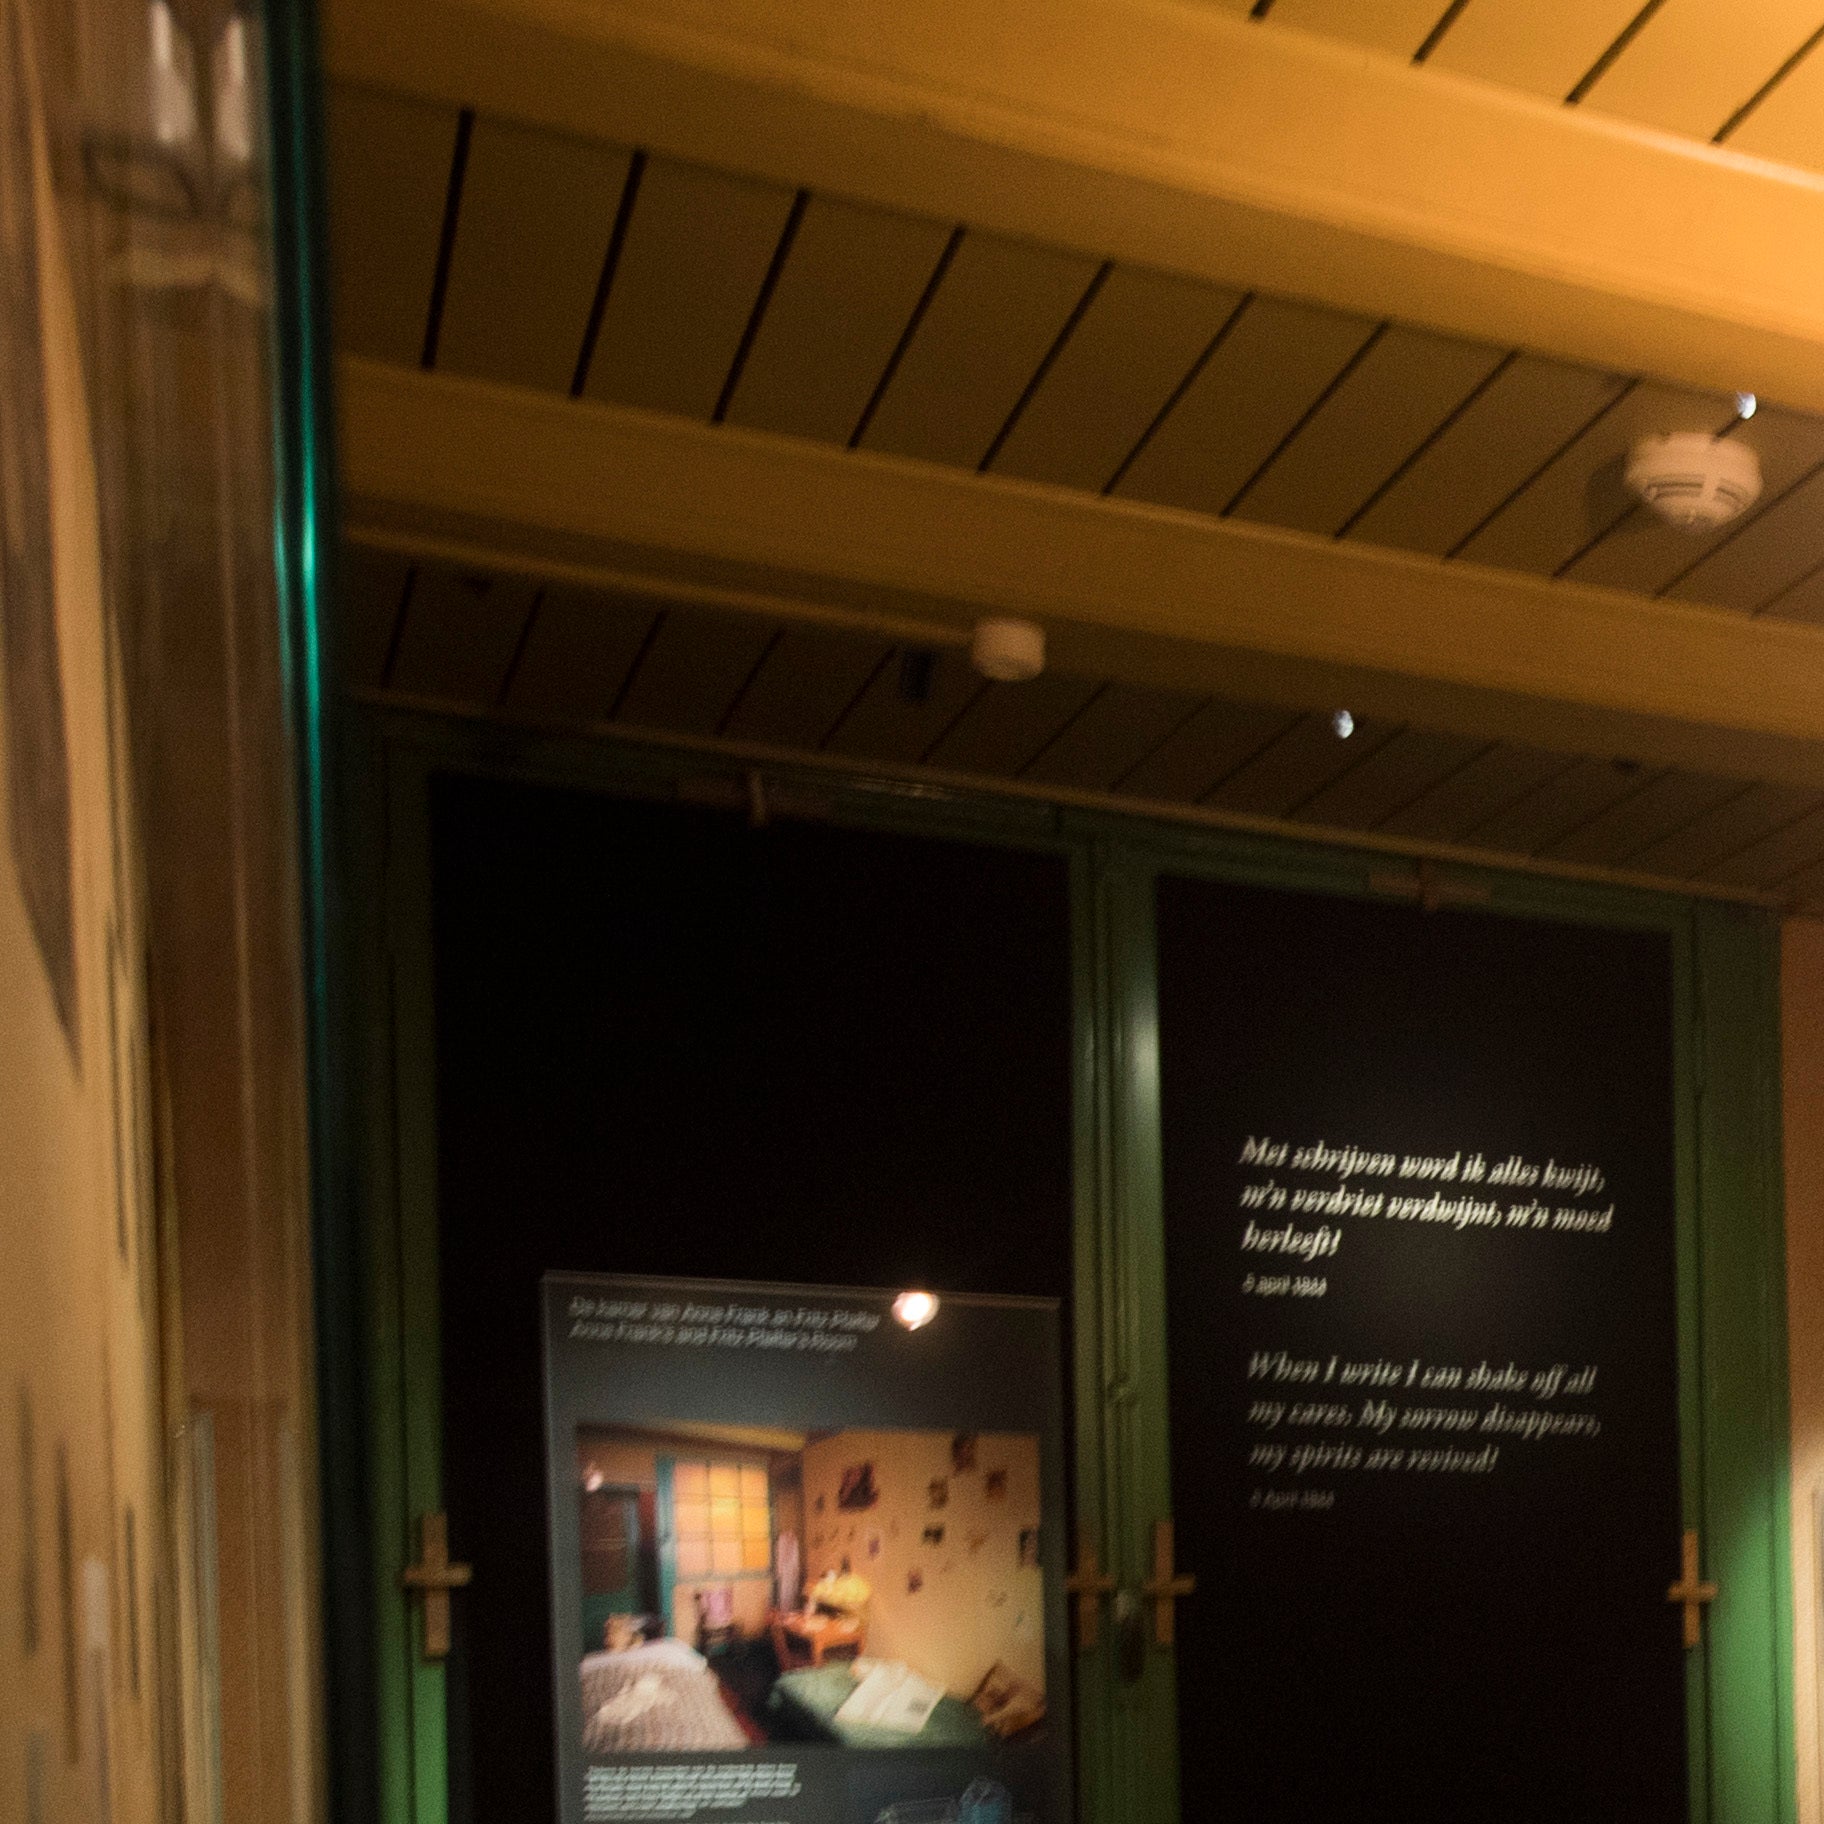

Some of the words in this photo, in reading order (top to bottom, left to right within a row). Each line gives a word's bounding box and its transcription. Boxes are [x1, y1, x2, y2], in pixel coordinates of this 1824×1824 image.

[1239, 1135, 1289, 1167] Met
[1291, 1139, 1396, 1180] schrijven
[1400, 1151, 1460, 1182] word
[1461, 1153, 1487, 1183] ik
[1487, 1155, 1540, 1188] alles
[1540, 1158, 1605, 1198] kwijt,
[1290, 1184, 1385, 1219] verdriet
[1386, 1191, 1501, 1230] verdwijnt,
[1551, 1203, 1614, 1232] moed
[1248, 1350, 1320, 1383] When
[1323, 1355, 1338, 1383] I
[1339, 1358, 1402, 1387] write
[1404, 1358, 1420, 1388] I
[1420, 1366, 1462, 1389] can
[1464, 1361, 1529, 1392] shake
[1530, 1364, 1568, 1399] off
[1564, 1364, 1598, 1395] all
[1248, 1400, 1286, 1430] my
[1288, 1402, 1353, 1428] cares,
[1357, 1400, 1398, 1434] My
[1400, 1403, 1479, 1432] sorrow
[1248, 1443, 1286, 1472] my
[1288, 1441, 1363, 1474] spirits
[1364, 1448, 1404, 1470] are
